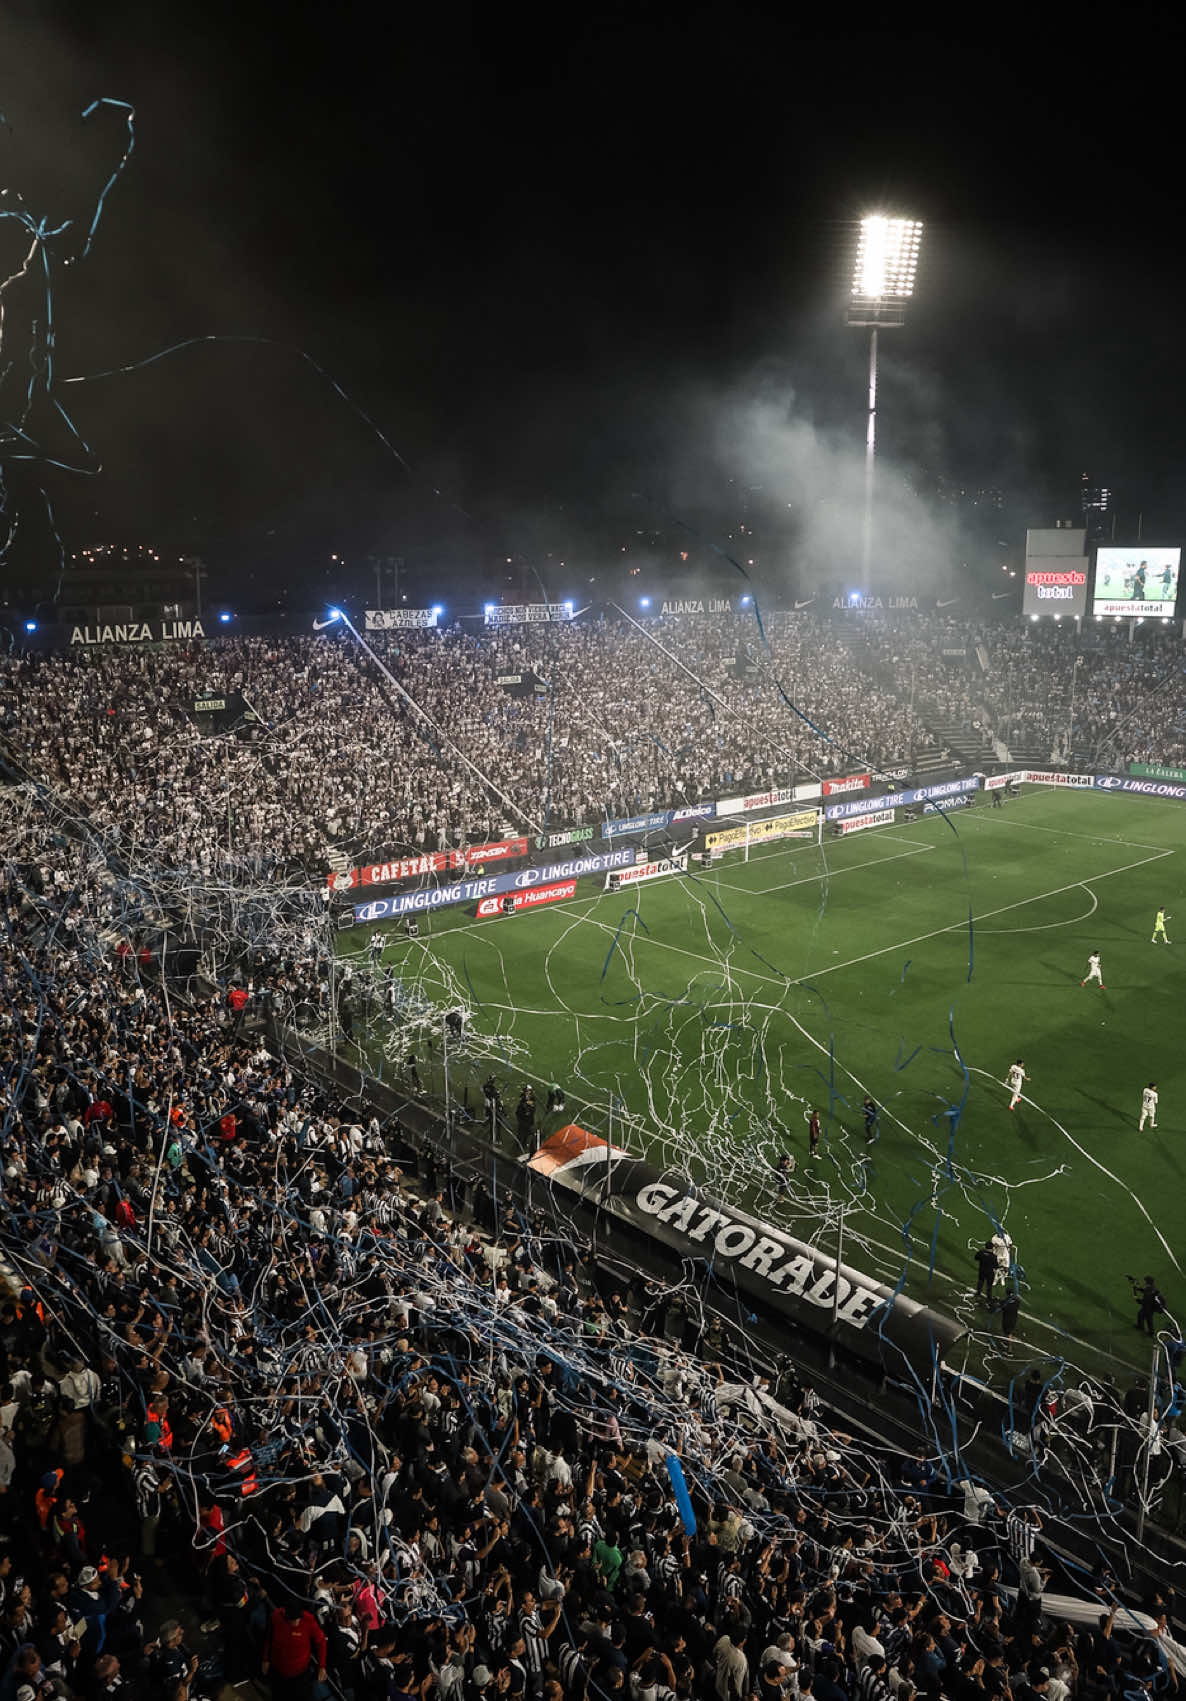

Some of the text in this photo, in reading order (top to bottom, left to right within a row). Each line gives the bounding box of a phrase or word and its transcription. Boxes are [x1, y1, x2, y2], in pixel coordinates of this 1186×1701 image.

[832, 595, 919, 608] ALIANZA LIMA
[1037, 586, 1073, 599] total
[661, 599, 732, 615] ALIANZA LIMA
[70, 621, 205, 644] ALIANZA LIMA
[196, 701, 224, 711] SALIDA
[927, 777, 977, 798] LINGLONG TIRE
[1026, 773, 1091, 786] apuestatotal
[1123, 781, 1186, 797] LINGLONG
[744, 787, 798, 808] apuestatotal
[846, 793, 904, 814] LINGLONG TIRE
[844, 812, 893, 832] puestatotal
[549, 828, 594, 848] TECNOGRASS
[371, 856, 438, 882] CAFETAL
[542, 858, 600, 881] LINGLONG
[603, 850, 631, 868] TIRE
[617, 855, 685, 882] puestatotal
[392, 878, 497, 913] LINGLONG TIRE
[524, 885, 575, 903] Huancayo
[636, 1183, 887, 1329] GATORADE
